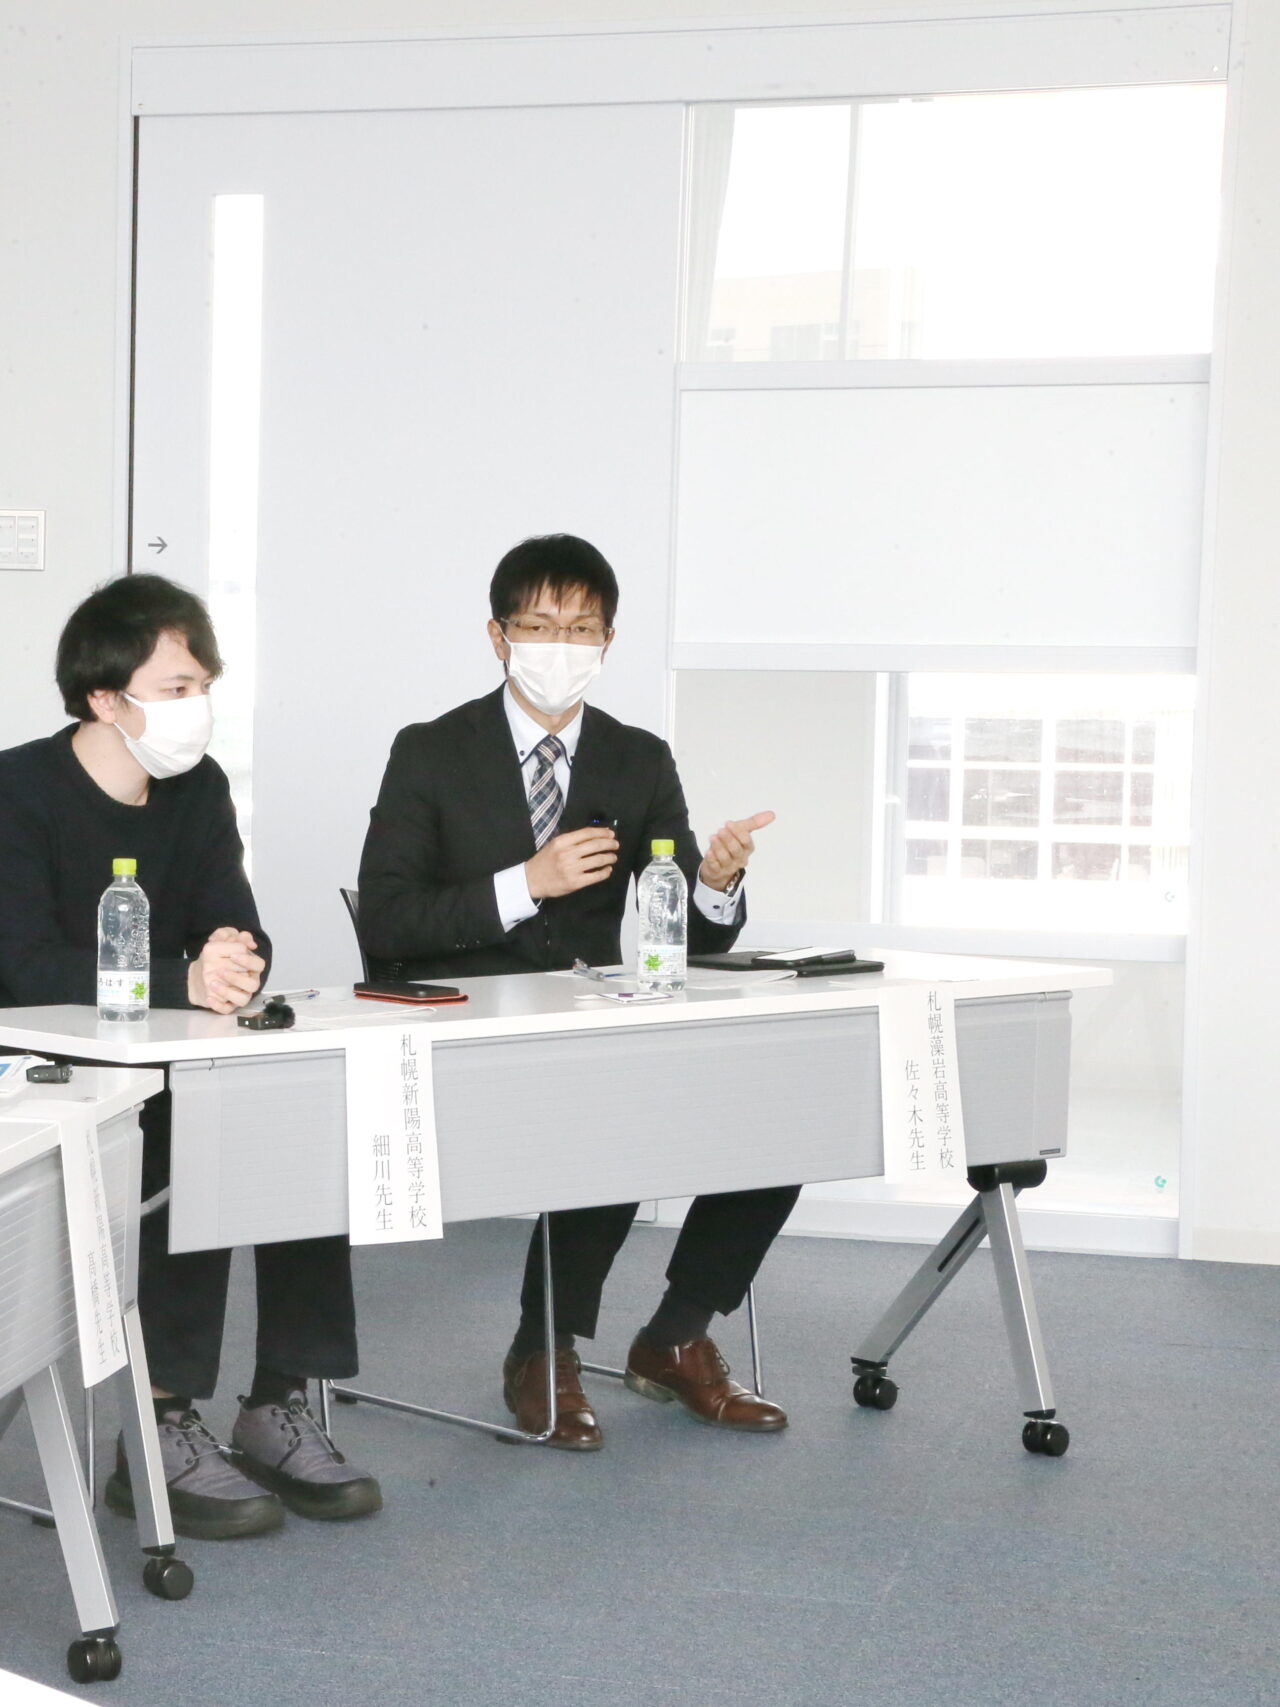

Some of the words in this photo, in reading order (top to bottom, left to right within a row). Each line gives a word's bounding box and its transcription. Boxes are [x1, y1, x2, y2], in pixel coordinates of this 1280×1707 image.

[400, 1033, 428, 1229] 札幌新陽高等学校
[904, 1059, 926, 1171] 佐々木先生
[927, 990, 955, 1169] 札幌藻岩高等学校
[372, 1133, 395, 1232] 細川先生
